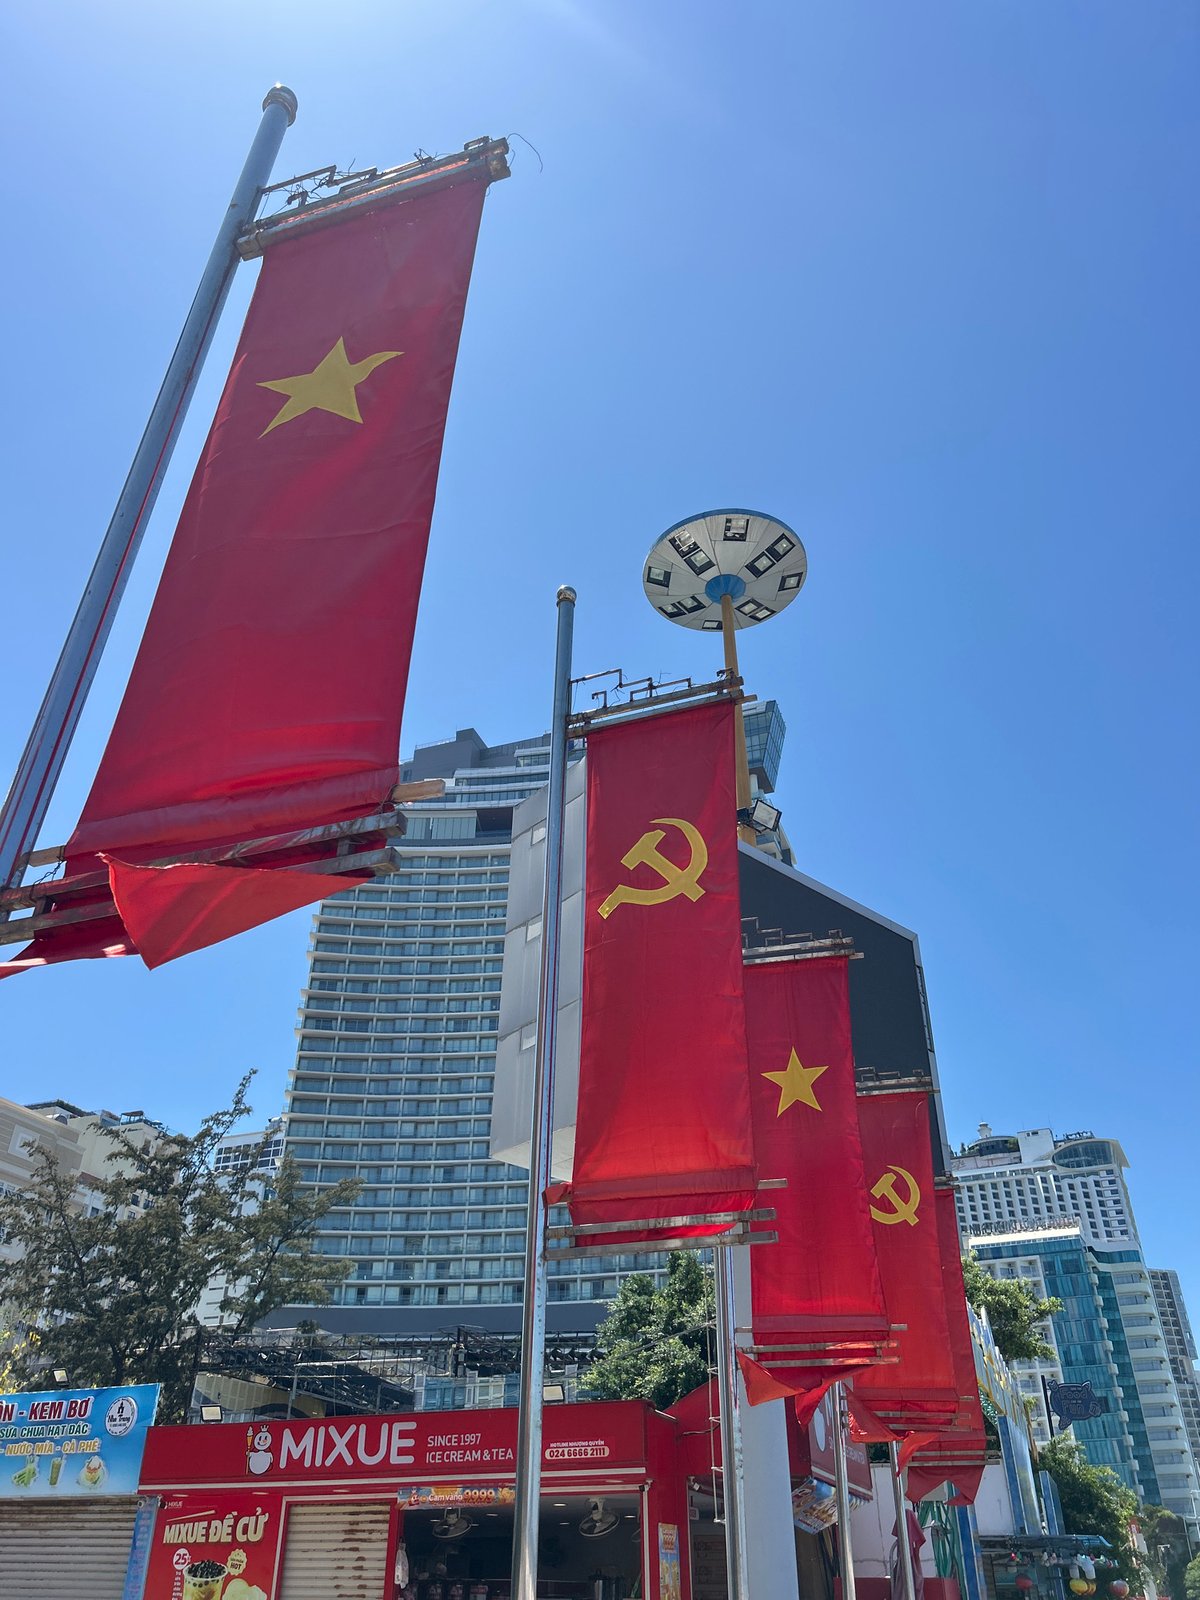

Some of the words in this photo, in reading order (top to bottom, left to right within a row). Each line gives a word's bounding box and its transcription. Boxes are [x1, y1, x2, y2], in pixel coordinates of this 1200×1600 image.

[0, 1401, 16, 1421] N
[28, 1402, 64, 1420] KEM
[67, 1397, 92, 1418] BƠ
[20, 1426, 44, 1437] CHUA
[47, 1425, 66, 1439] HẠT
[35, 1440, 54, 1454] MÍA
[279, 1422, 417, 1469] MIXUE
[427, 1435, 459, 1447] SINCE
[460, 1433, 481, 1446] 1997
[426, 1451, 443, 1463] ICE
[443, 1450, 481, 1462] CREAM
[483, 1449, 490, 1461] &
[491, 1448, 514, 1460] TEA
[549, 1450, 566, 1458] 024
[567, 1449, 588, 1457] 6666
[590, 1448, 605, 1456] 2111
[428, 1494, 444, 1502] Cam
[464, 1490, 495, 1503] 9999
[163, 1521, 208, 1543] MIXUE
[236, 1507, 269, 1542] CỬ
[230, 1562, 241, 1570] HOT
